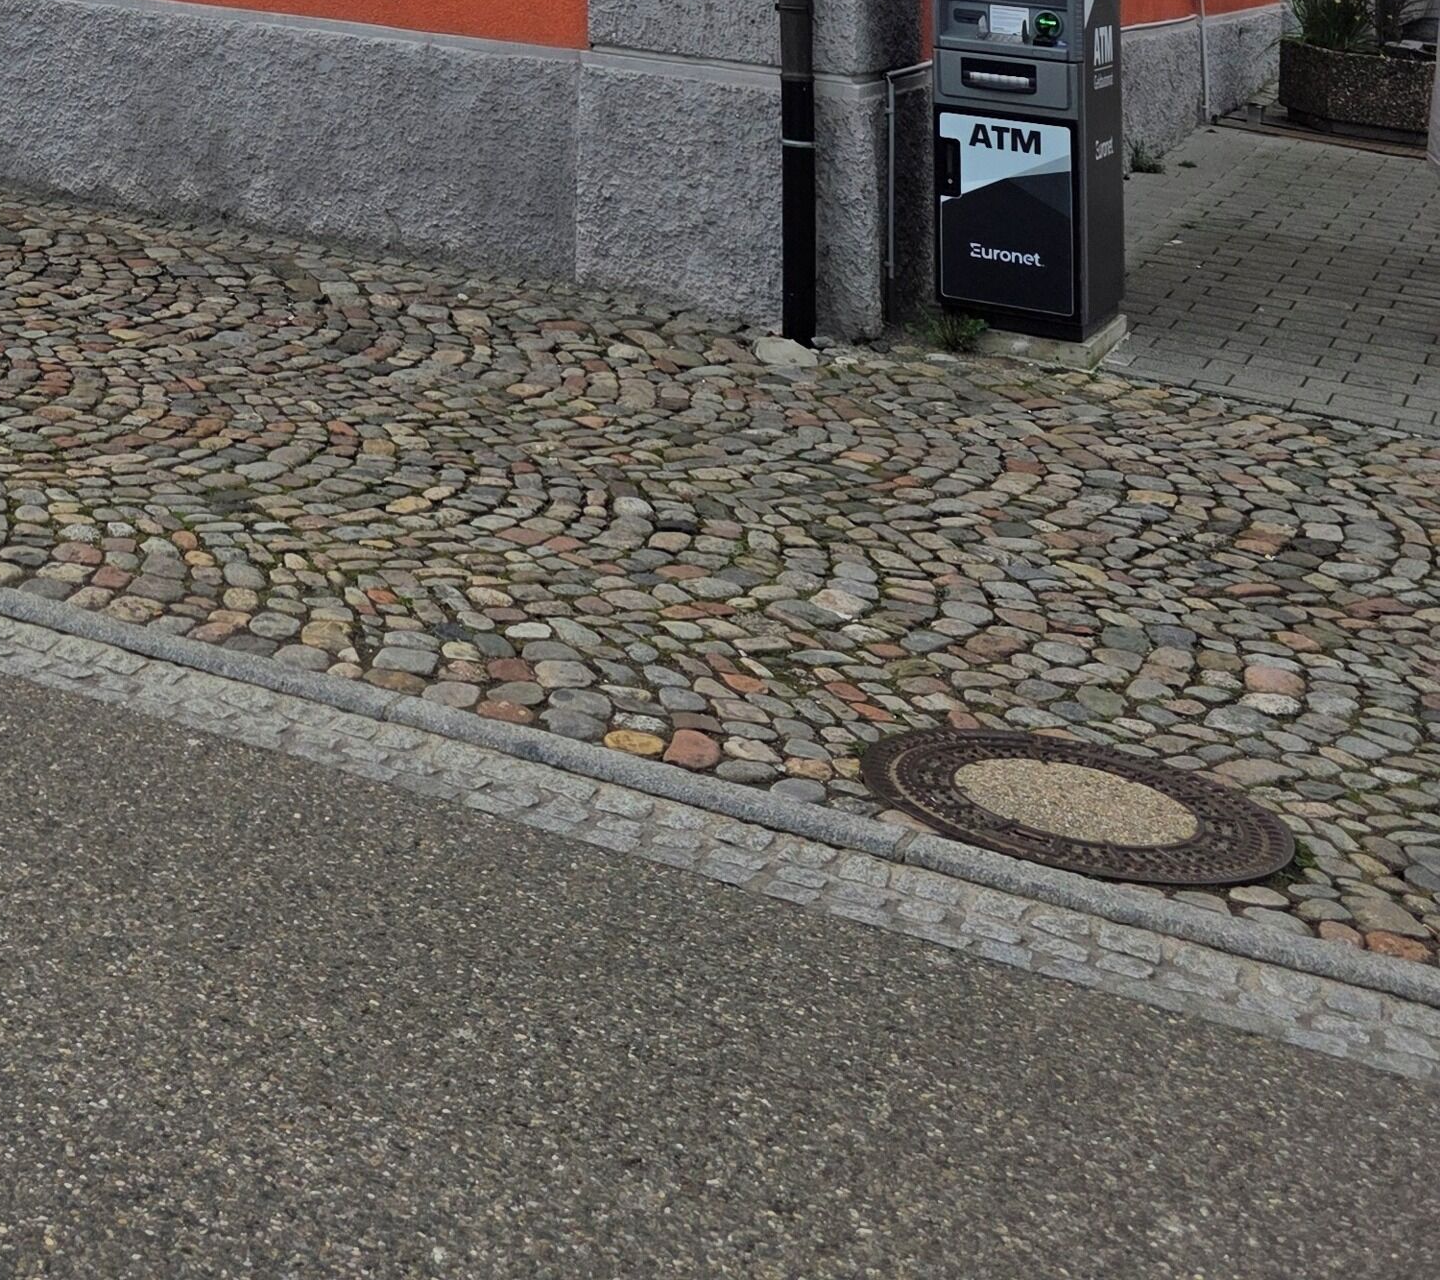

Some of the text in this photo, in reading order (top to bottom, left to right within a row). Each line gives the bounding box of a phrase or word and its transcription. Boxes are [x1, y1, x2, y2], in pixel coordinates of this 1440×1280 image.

[1093, 24, 1114, 67] ATM
[969, 123, 1042, 156] ATM
[969, 242, 1043, 267] Euronet
